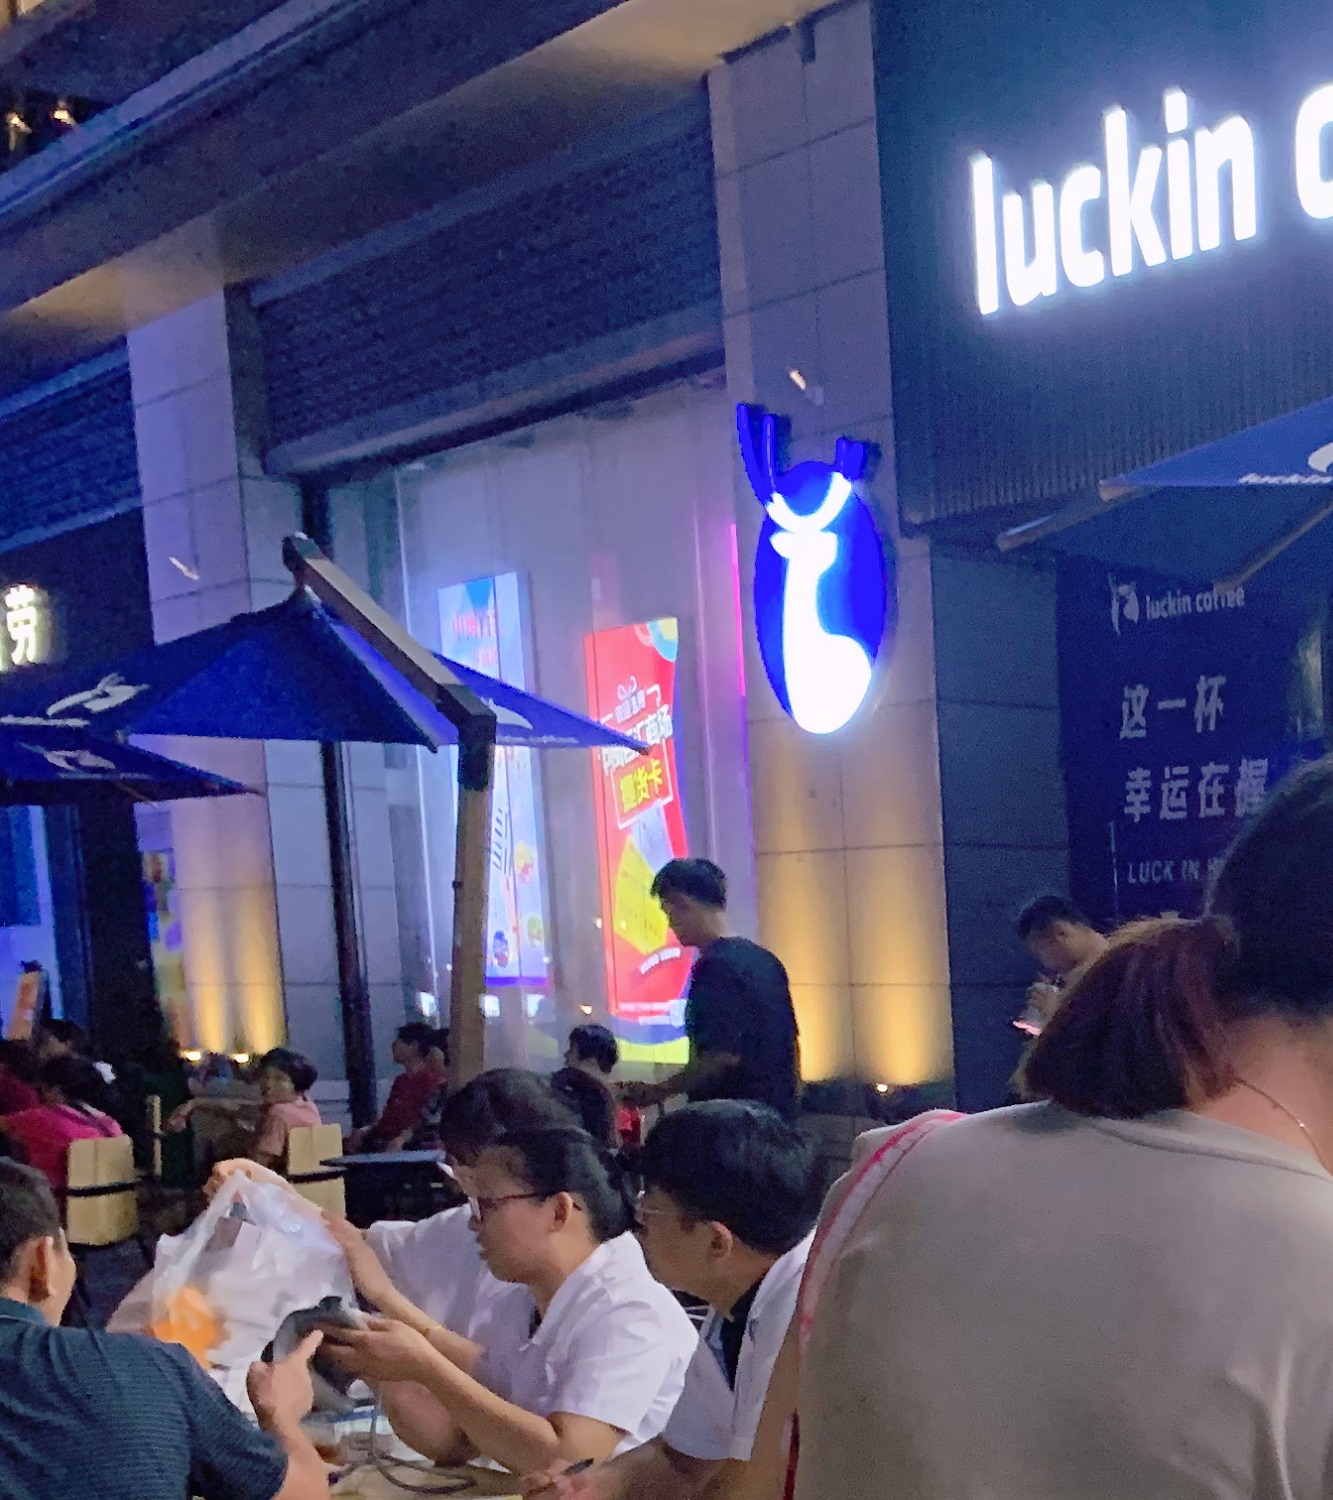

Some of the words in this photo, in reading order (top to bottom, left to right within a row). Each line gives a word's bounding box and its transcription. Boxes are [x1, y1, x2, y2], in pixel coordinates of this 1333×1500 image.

[968, 88, 1257, 316] luckin
[1146, 587, 1192, 620] luckin
[1119, 675, 1227, 740] 这一杯
[1124, 758, 1268, 822] 幸运在握
[1127, 860, 1174, 884] LUCK
[1182, 858, 1200, 881] IN
